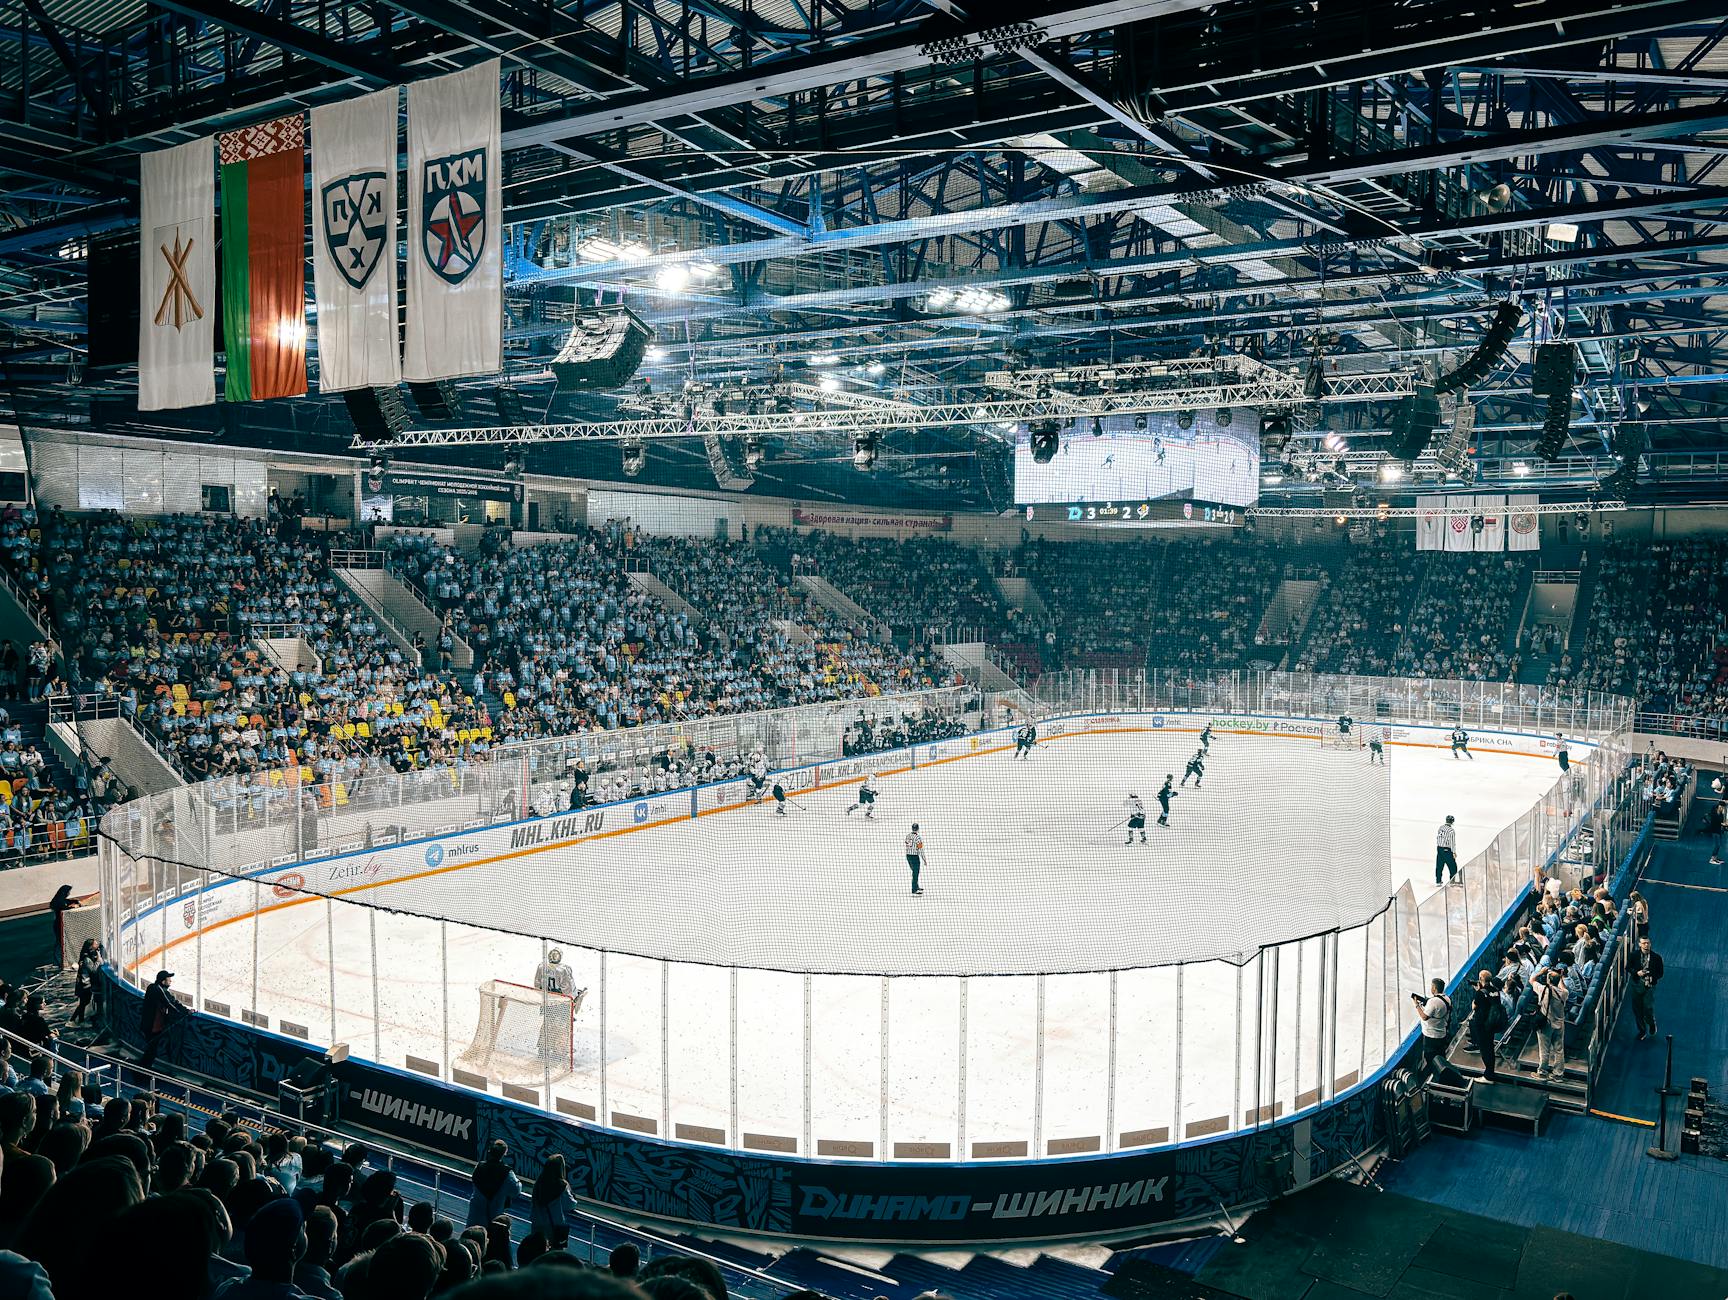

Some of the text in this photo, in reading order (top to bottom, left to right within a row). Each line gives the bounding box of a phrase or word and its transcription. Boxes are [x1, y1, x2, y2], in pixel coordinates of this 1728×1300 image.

[1087, 507, 1096, 520] 3
[1099, 507, 1118, 515] 01:39
[1122, 506, 1131, 519] 2
[510, 811, 605, 848] MHL.KHL.RU
[448, 844, 480, 857] mhlrus
